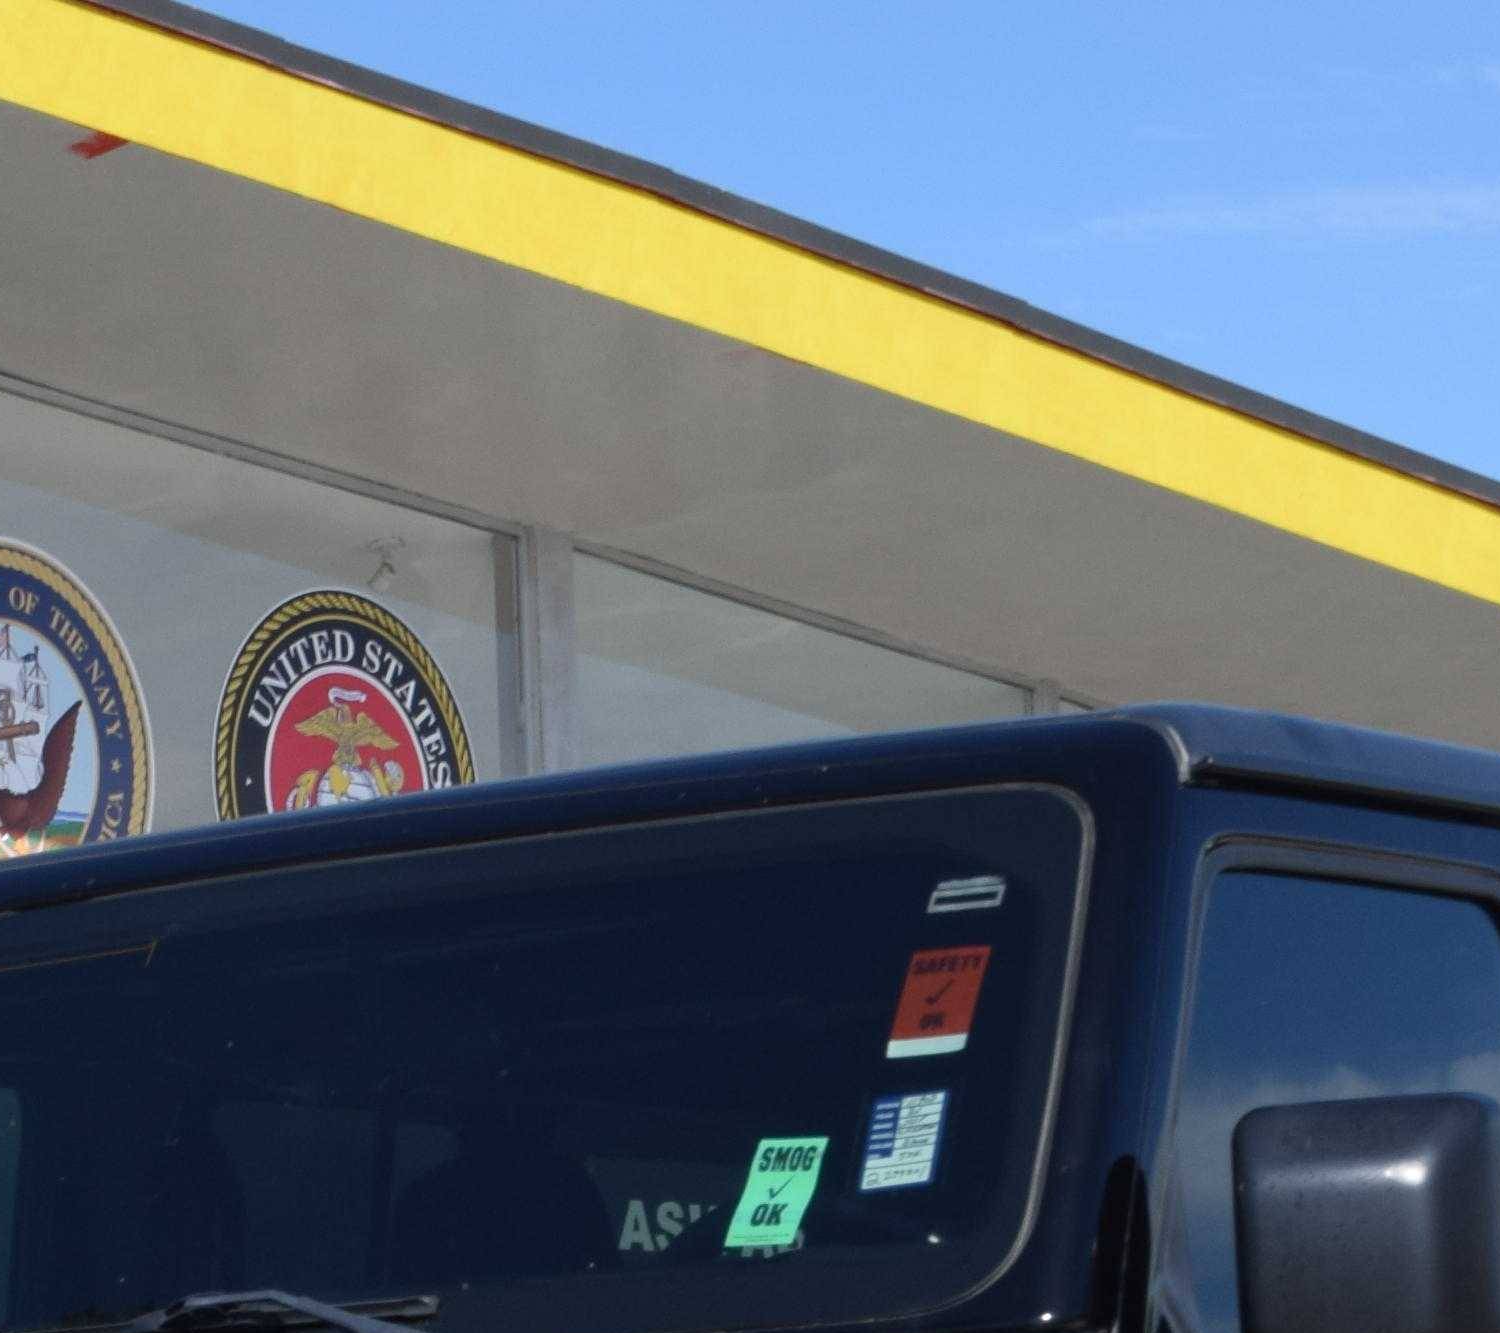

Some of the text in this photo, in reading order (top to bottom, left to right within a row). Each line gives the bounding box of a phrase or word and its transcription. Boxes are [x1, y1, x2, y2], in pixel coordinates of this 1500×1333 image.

[8, 586, 40, 615] OF
[51, 606, 89, 661] THE
[85, 662, 124, 740] NAVY
[248, 629, 453, 790] UNITED STATES
[757, 1145, 819, 1173] SMOG
[617, 1199, 717, 1253] AS
[750, 1203, 788, 1227] OK
